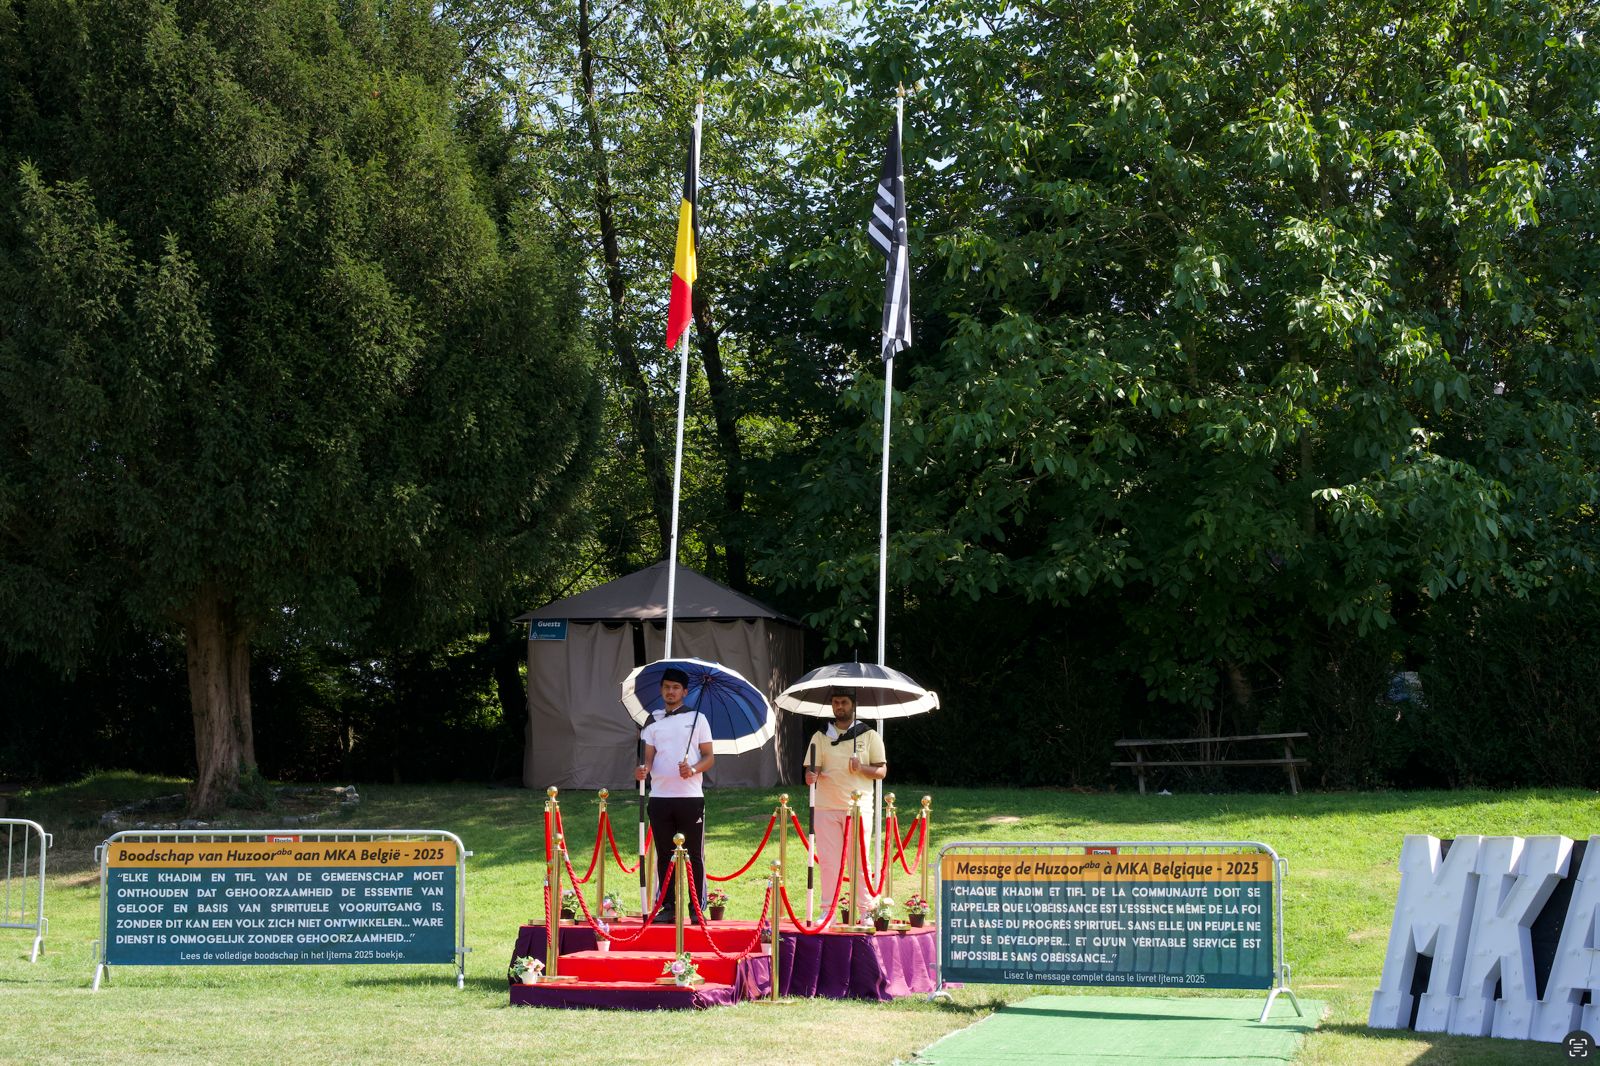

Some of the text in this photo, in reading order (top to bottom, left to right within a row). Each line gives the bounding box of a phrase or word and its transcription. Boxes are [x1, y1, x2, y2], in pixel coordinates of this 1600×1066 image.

[119, 849, 195, 864] Boodschap
[199, 851, 223, 862] van
[294, 850, 319, 861] aan
[324, 850, 356, 861] MKA
[360, 849, 400, 864] België
[414, 848, 444, 860] 2025
[957, 862, 1012, 878] Message
[1015, 861, 1031, 876] de
[1104, 861, 1112, 875] à
[1116, 862, 1148, 875] MKA
[1153, 862, 1212, 879] Belgique
[1227, 862, 1259, 875] 2025
[158, 873, 201, 882] KHADIM
[211, 873, 226, 882] EN
[235, 872, 256, 882] TIFL
[265, 872, 288, 882] VAN
[298, 872, 312, 882] DE
[321, 872, 404, 882] GEMEENSCHAP
[413, 872, 443, 881] MOET
[117, 887, 443, 898] ONTHOUDEN DAT GEHOORZAAMHEID DE ESSENTIE VAN
[1003, 886, 1043, 897] KHADIM
[1050, 887, 1059, 897] ET
[1066, 887, 1086, 897] TIFL
[1092, 887, 1106, 897] DE
[1112, 887, 1126, 897] LA
[1214, 887, 1241, 897] DOIT
[1248, 887, 1260, 897] SE
[117, 902, 444, 913] GELOOF EN BASIS VAN SPIRITUELE VOORUITGANG IS.
[951, 903, 1000, 913] RAPPELER
[1002, 903, 1023, 913] QUE
[1100, 903, 1117, 913] EST
[1208, 904, 1222, 914] DE
[1225, 904, 1239, 914] LA
[1242, 904, 1260, 914] FOI
[117, 919, 163, 929] ZONDER
[165, 919, 182, 929] DIT
[186, 919, 209, 929] KAN
[212, 918, 233, 929] EEN
[236, 918, 265, 929] VOLK
[268, 918, 295, 928] ZICH
[298, 918, 321, 928] NIET
[412, 917, 443, 927] WARE
[951, 919, 961, 929] ET
[964, 919, 976, 929] LA
[979, 919, 1003, 929] BASE
[1006, 919, 1020, 929] DU
[1074, 919, 1125, 930] SPIRITUEL.
[1128, 920, 1156, 930] SANS
[1158, 920, 1185, 932] ELLE,
[1187, 920, 1202, 931] UN
[1205, 921, 1244, 931] PEUPLE
[1246, 921, 1260, 931] NE
[116, 934, 154, 944] DIENST
[157, 934, 166, 944] IS
[170, 934, 244, 944] ONMOGELIJK
[248, 933, 293, 944] ZONDER
[951, 935, 974, 945] PEUT
[981, 935, 992, 945] SE
[1076, 936, 1087, 946] ET
[1193, 937, 1236, 948] SERVICE
[1243, 938, 1260, 948] EST
[180, 951, 200, 960] Lees
[203, 951, 212, 960] de
[215, 951, 252, 962] volledige
[255, 951, 299, 961] boodschap
[301, 951, 308, 959] in
[311, 951, 324, 959] het
[354, 950, 374, 959] 2025
[376, 950, 406, 960] boekje.
[951, 951, 1008, 961] IMPOSSIBLE
[1011, 952, 1038, 961] SANS
[1004, 971, 1024, 980] Lisez
[1026, 972, 1033, 980] le
[1035, 973, 1070, 983] message
[1072, 973, 1103, 983] complet
[1186, 975, 1207, 983] 2025.
